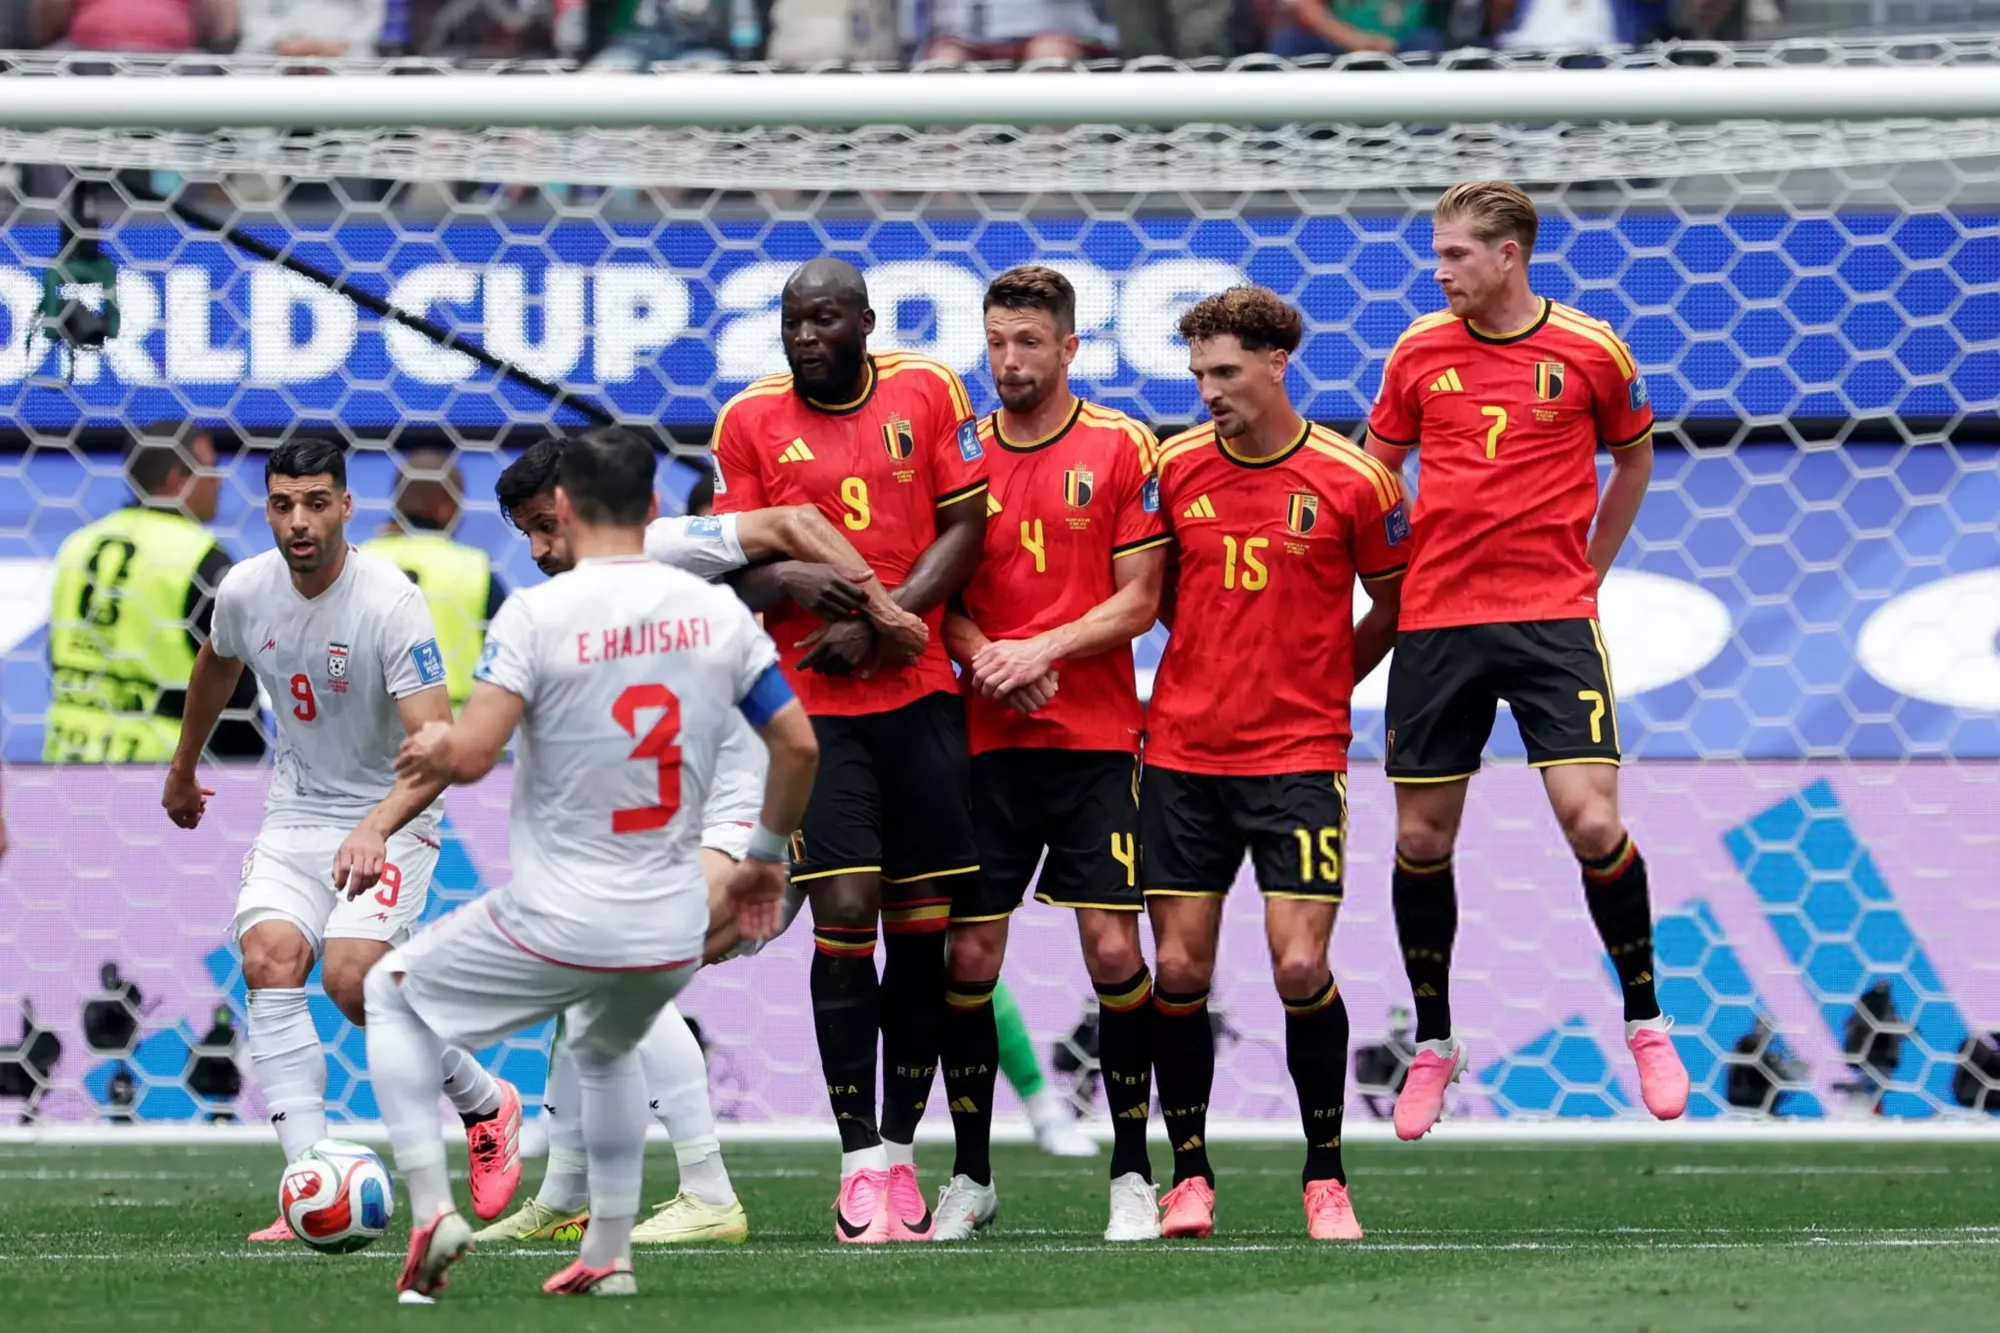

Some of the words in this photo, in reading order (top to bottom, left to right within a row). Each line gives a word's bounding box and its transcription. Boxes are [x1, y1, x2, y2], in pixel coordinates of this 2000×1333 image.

[382, 263, 695, 385] CUP
[1480, 405, 1508, 460] 7
[840, 476, 871, 531] 9
[1020, 518, 1046, 573] 4
[1222, 535, 1269, 591] 15
[290, 673, 317, 722] 9
[1577, 690, 1605, 743] 7
[611, 683, 682, 835] 3
[1110, 831, 1135, 887] 4
[1293, 826, 1339, 883] 15
[374, 861, 402, 908] 9
[897, 1065, 938, 1079] RBF
